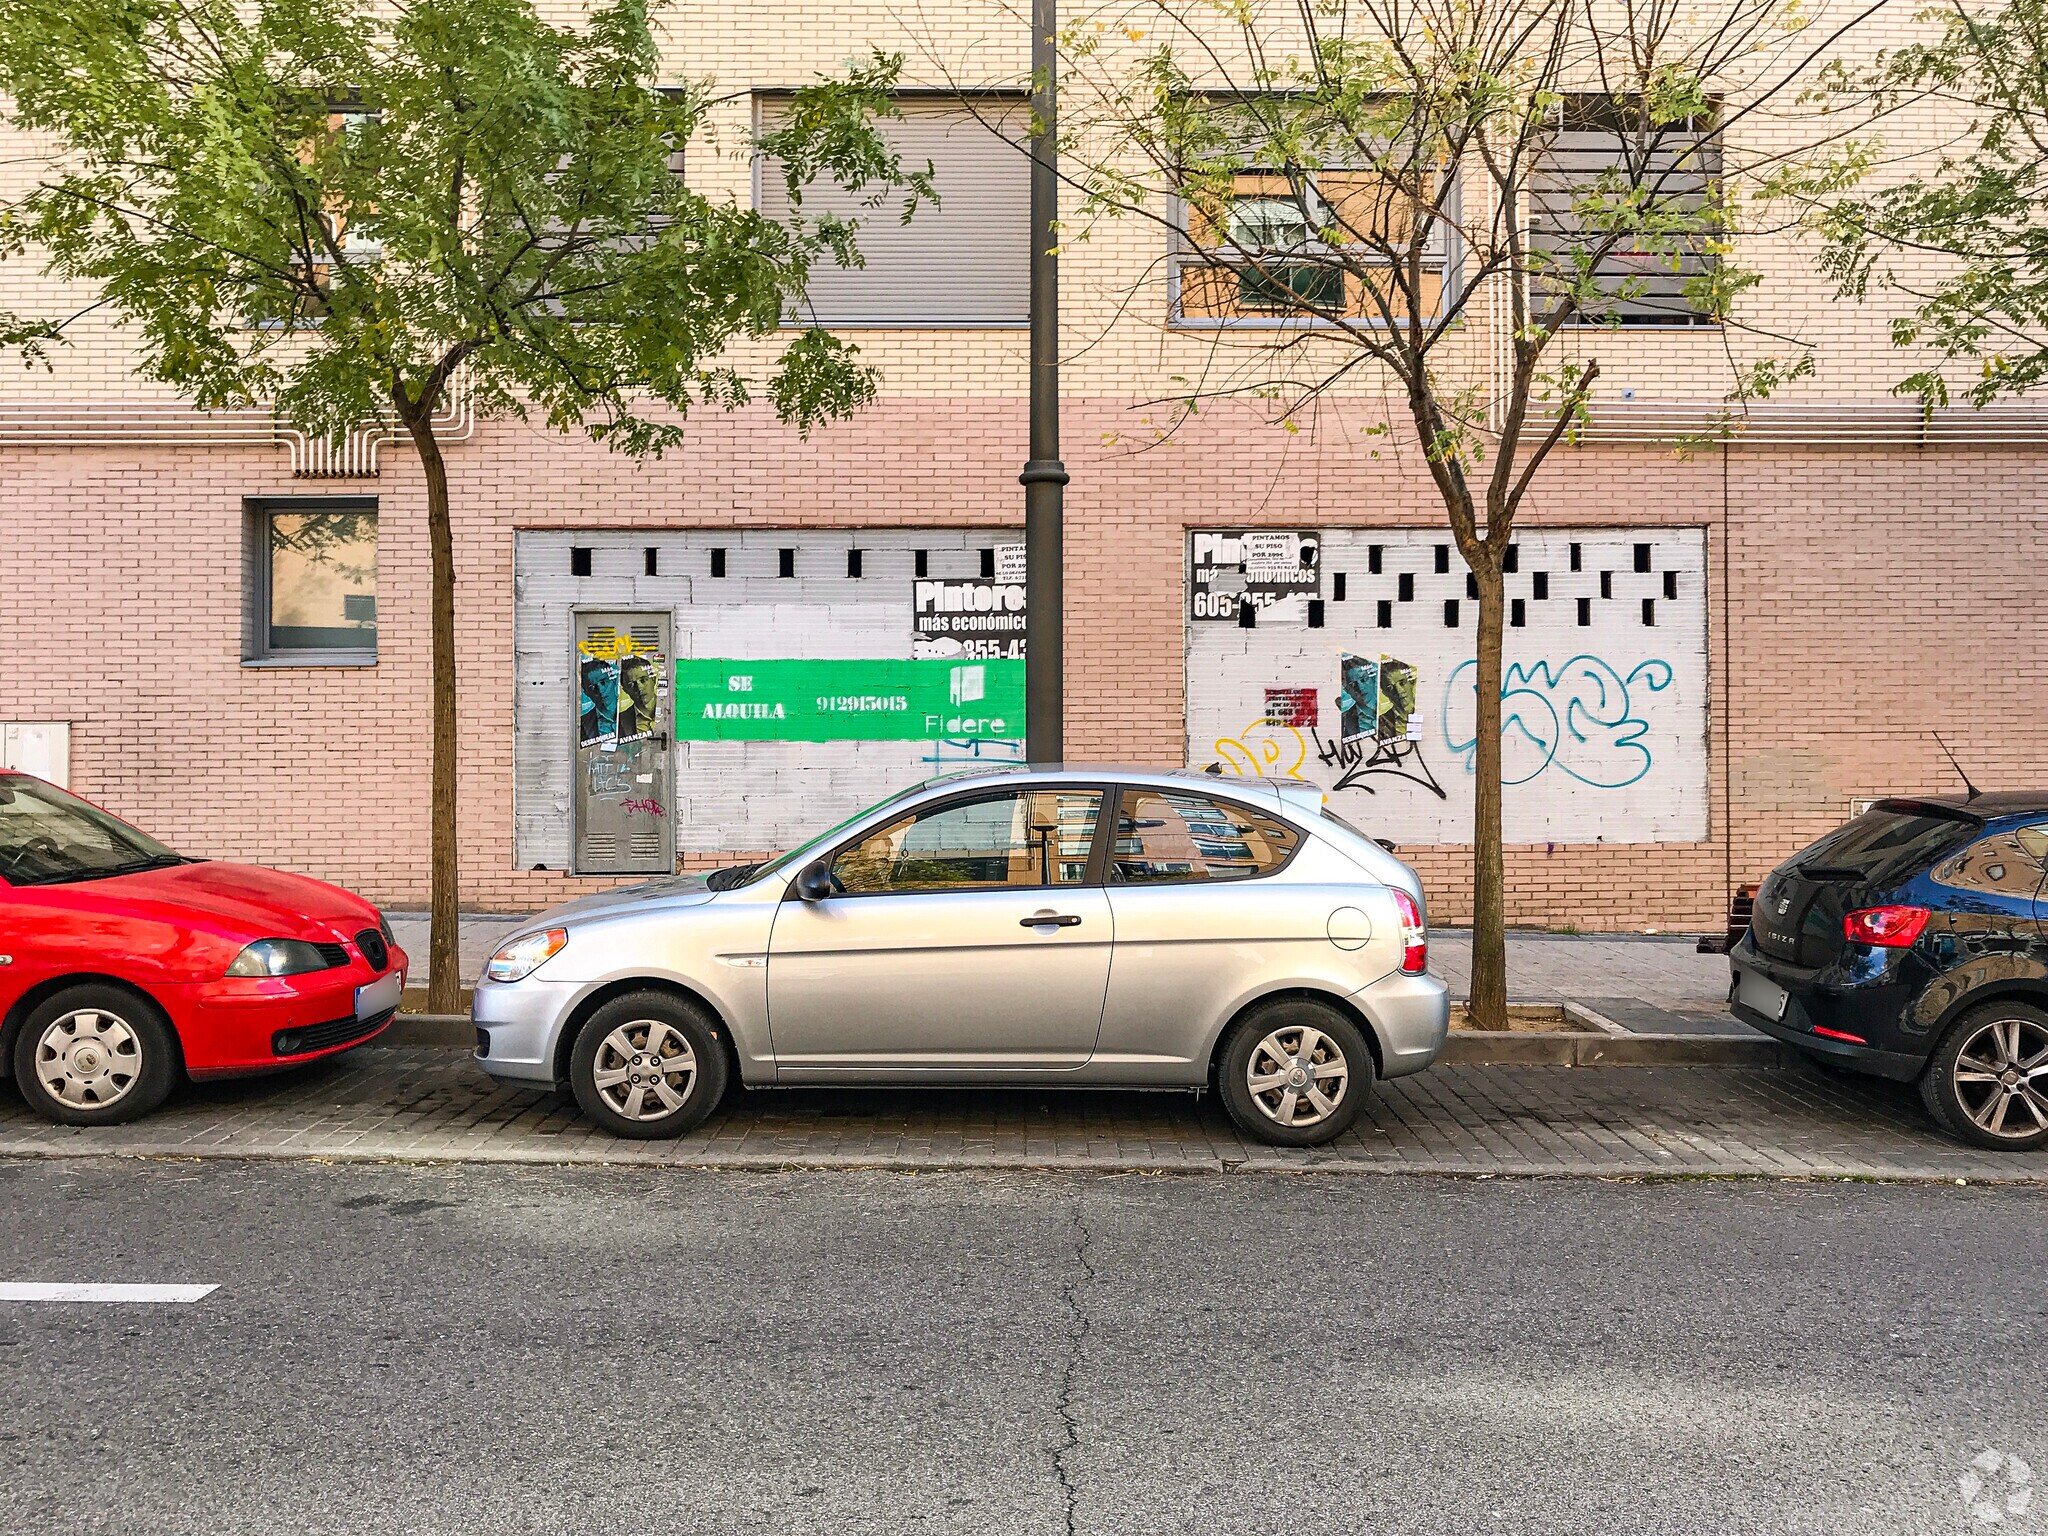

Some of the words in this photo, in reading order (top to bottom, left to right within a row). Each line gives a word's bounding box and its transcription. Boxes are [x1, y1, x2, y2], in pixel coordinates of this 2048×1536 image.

[1196, 565, 1218, 583] má
[916, 581, 1026, 612] Pintore
[919, 613, 949, 631] más
[728, 675, 753, 692] SE
[701, 703, 785, 719] ALQUILA
[816, 696, 908, 711] 912915015
[925, 715, 1005, 733] Fidere
[580, 731, 616, 748] DESBLOQUEAR
[619, 730, 653, 745] AVANZAR
[1379, 734, 1407, 747] AVANZA
[1767, 931, 1796, 945] IBIZA
